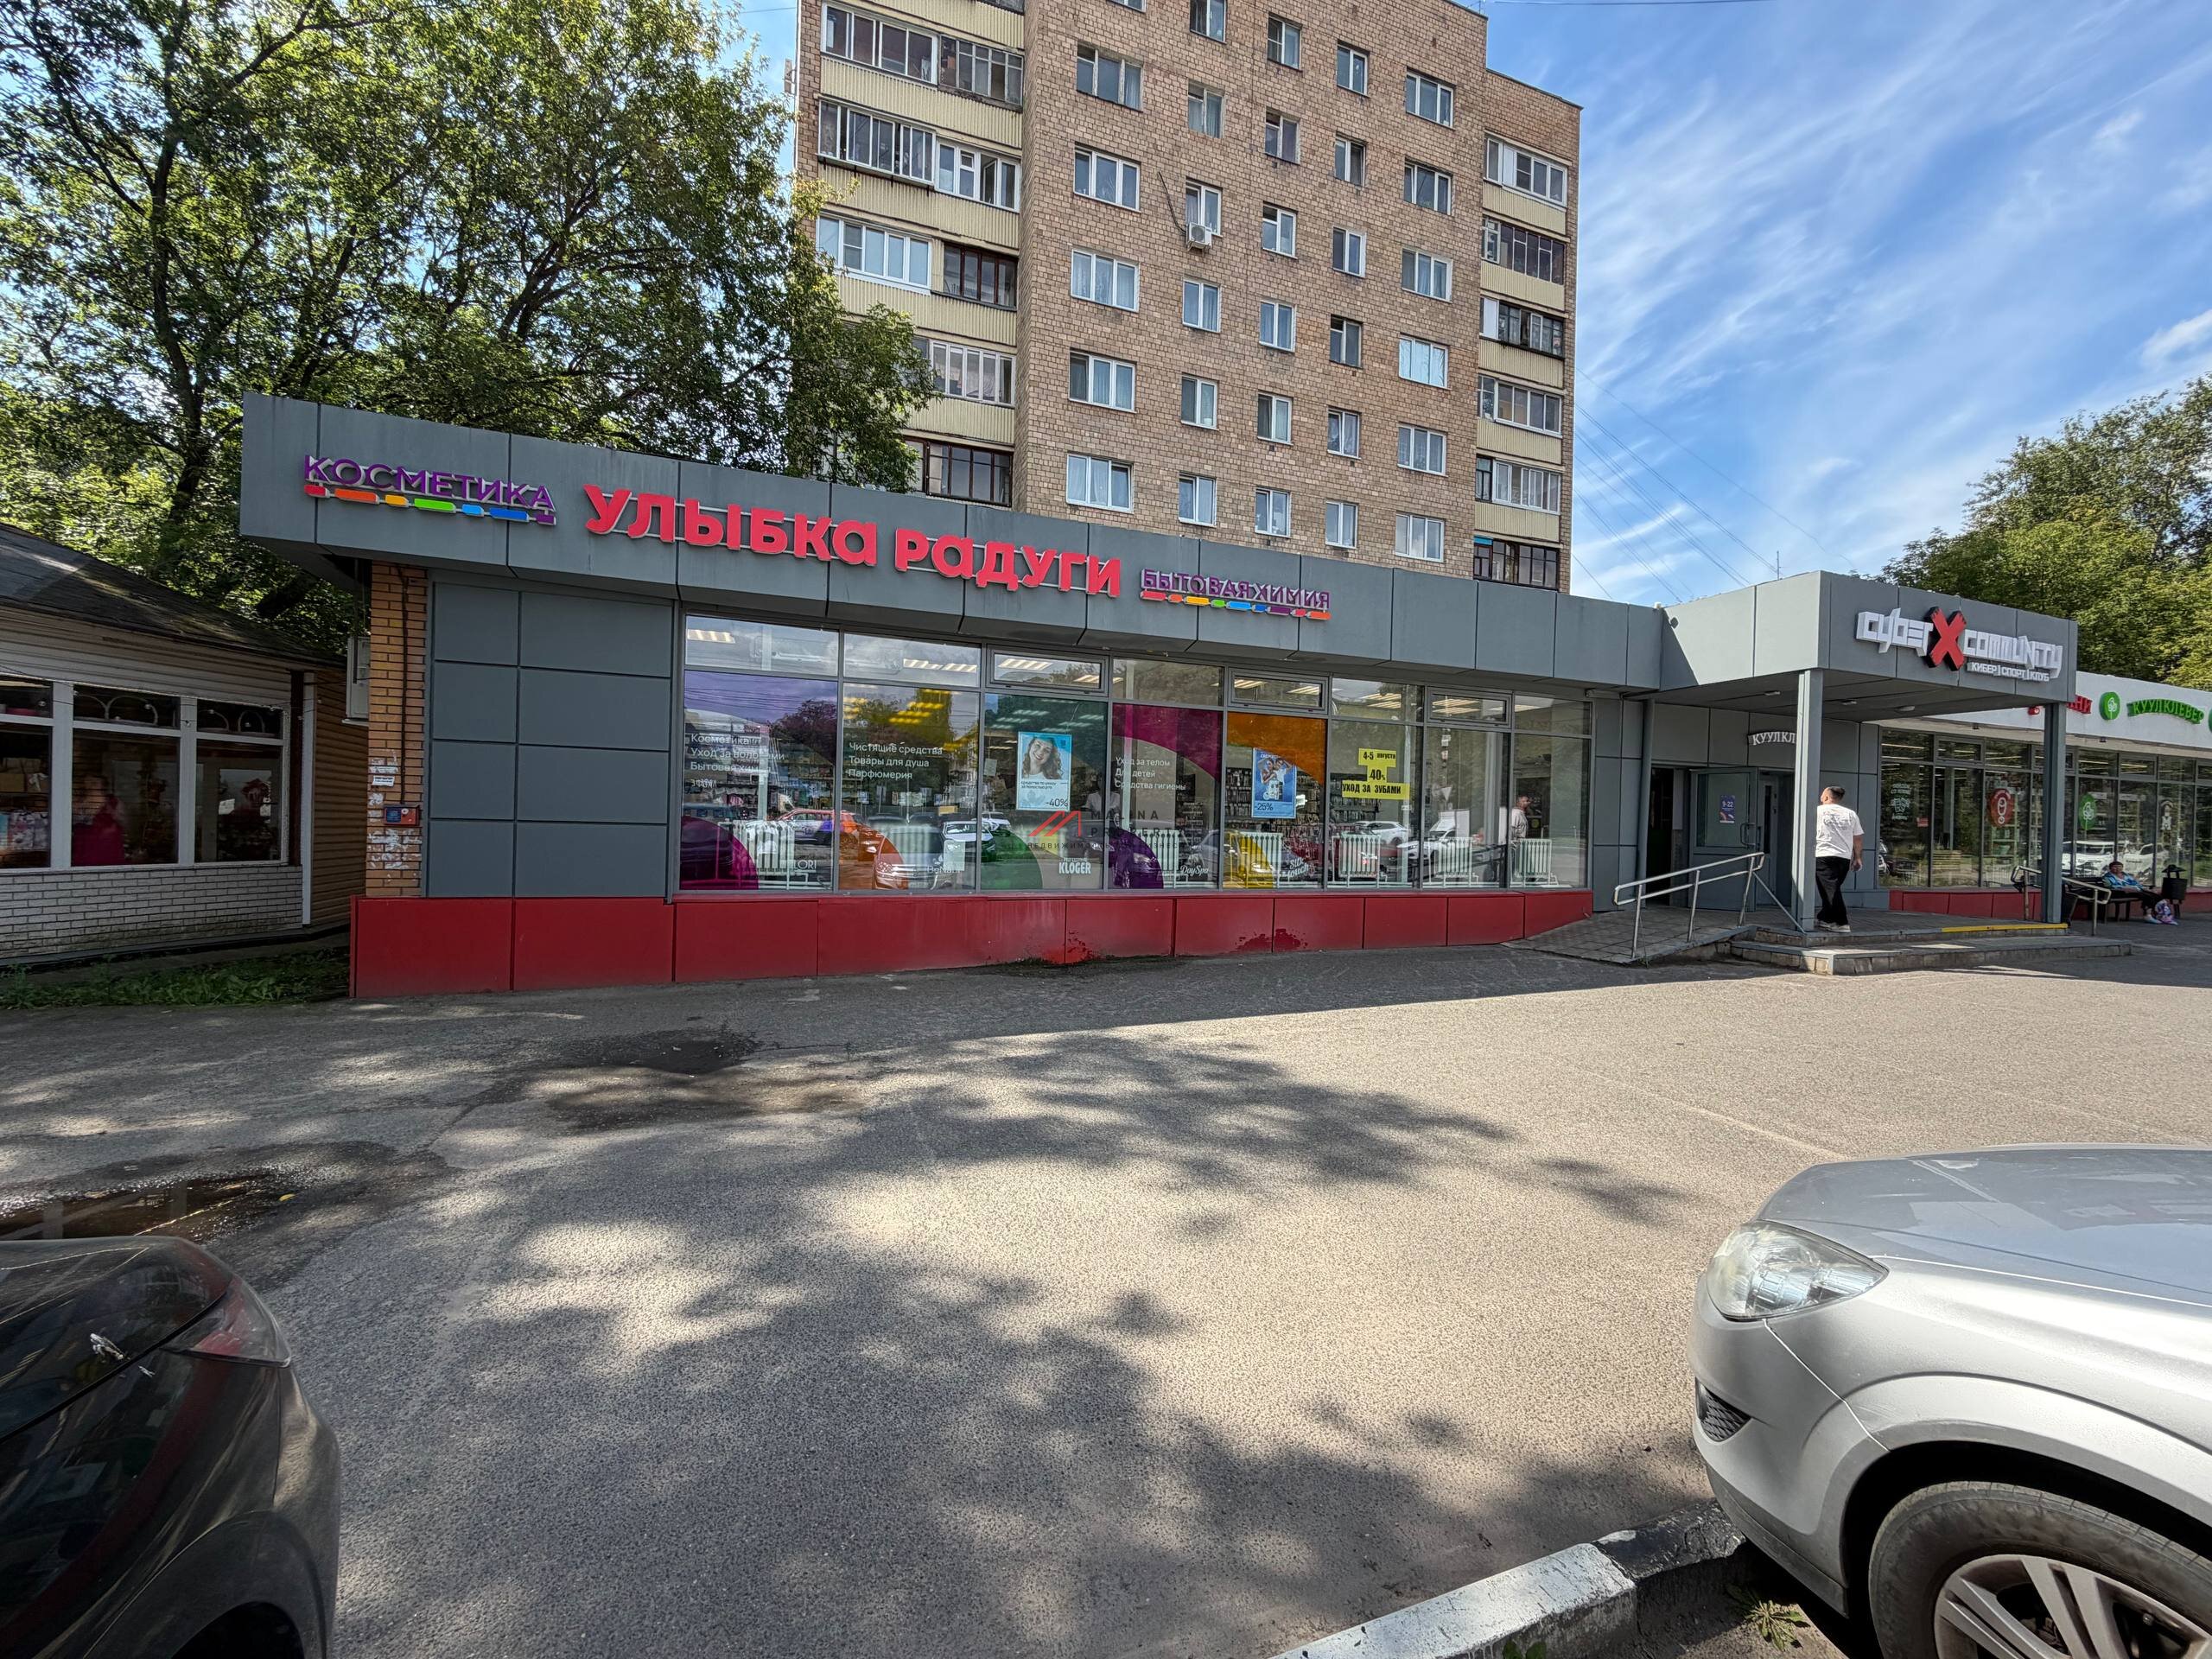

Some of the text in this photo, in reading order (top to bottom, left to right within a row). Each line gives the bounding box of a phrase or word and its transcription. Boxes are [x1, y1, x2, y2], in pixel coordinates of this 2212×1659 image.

[305, 455, 556, 512] КОСМЕТИКА
[1141, 569, 1330, 609] БЫТОВАЯ ХИМИЯ
[1752, 731, 1796, 746] КУУЛКЛ
[691, 747, 717, 758] Уход
[733, 751, 785, 760] воломи
[849, 742, 943, 755] Чистящие средства
[849, 755, 884, 766] Товары
[905, 760, 930, 768] душа
[1116, 757, 1135, 766] Ухд
[1363, 752, 1374, 760] 4-5
[849, 769, 912, 780] Парфюмерия
[1114, 779, 1154, 789] Срдства
[1342, 783, 1402, 794] УХОД ЗА ЗУБАМИ
[1046, 798, 1069, 807] -40%
[1058, 861, 1092, 874] KLOGER
